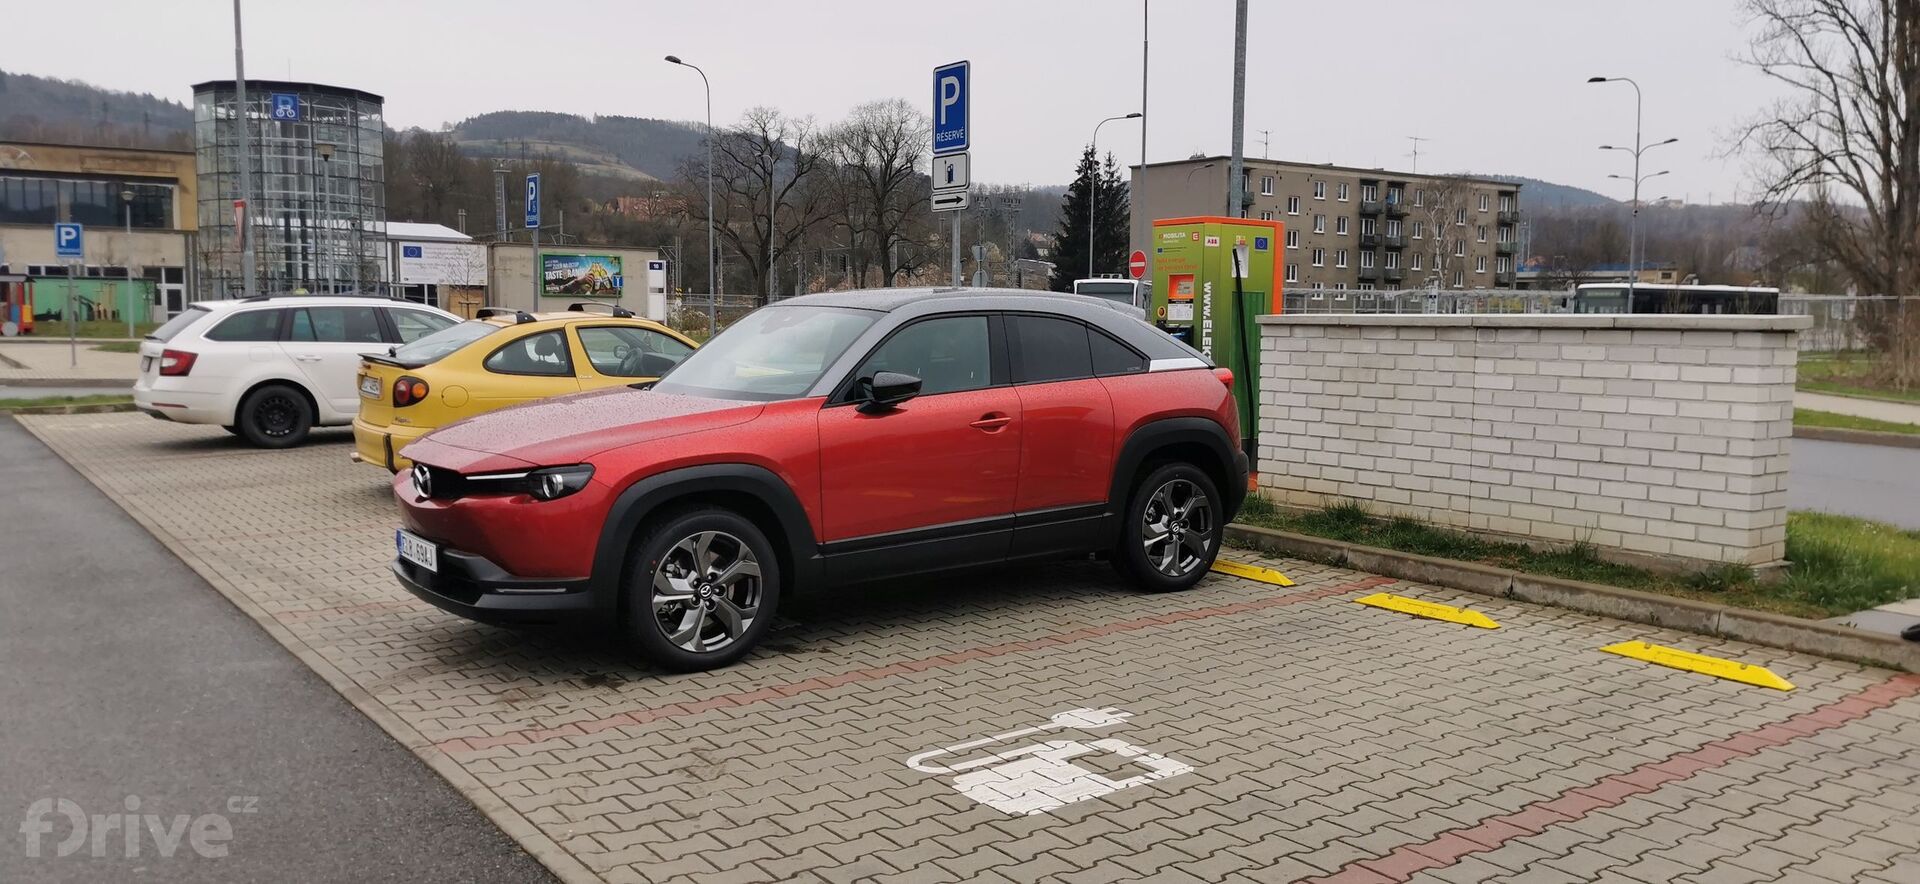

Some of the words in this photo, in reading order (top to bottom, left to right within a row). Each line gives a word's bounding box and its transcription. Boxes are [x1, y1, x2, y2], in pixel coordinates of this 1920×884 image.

[941, 75, 960, 125] P
[936, 127, 964, 142] RÉSERVÉ
[528, 181, 536, 211] P
[60, 227, 77, 246] P
